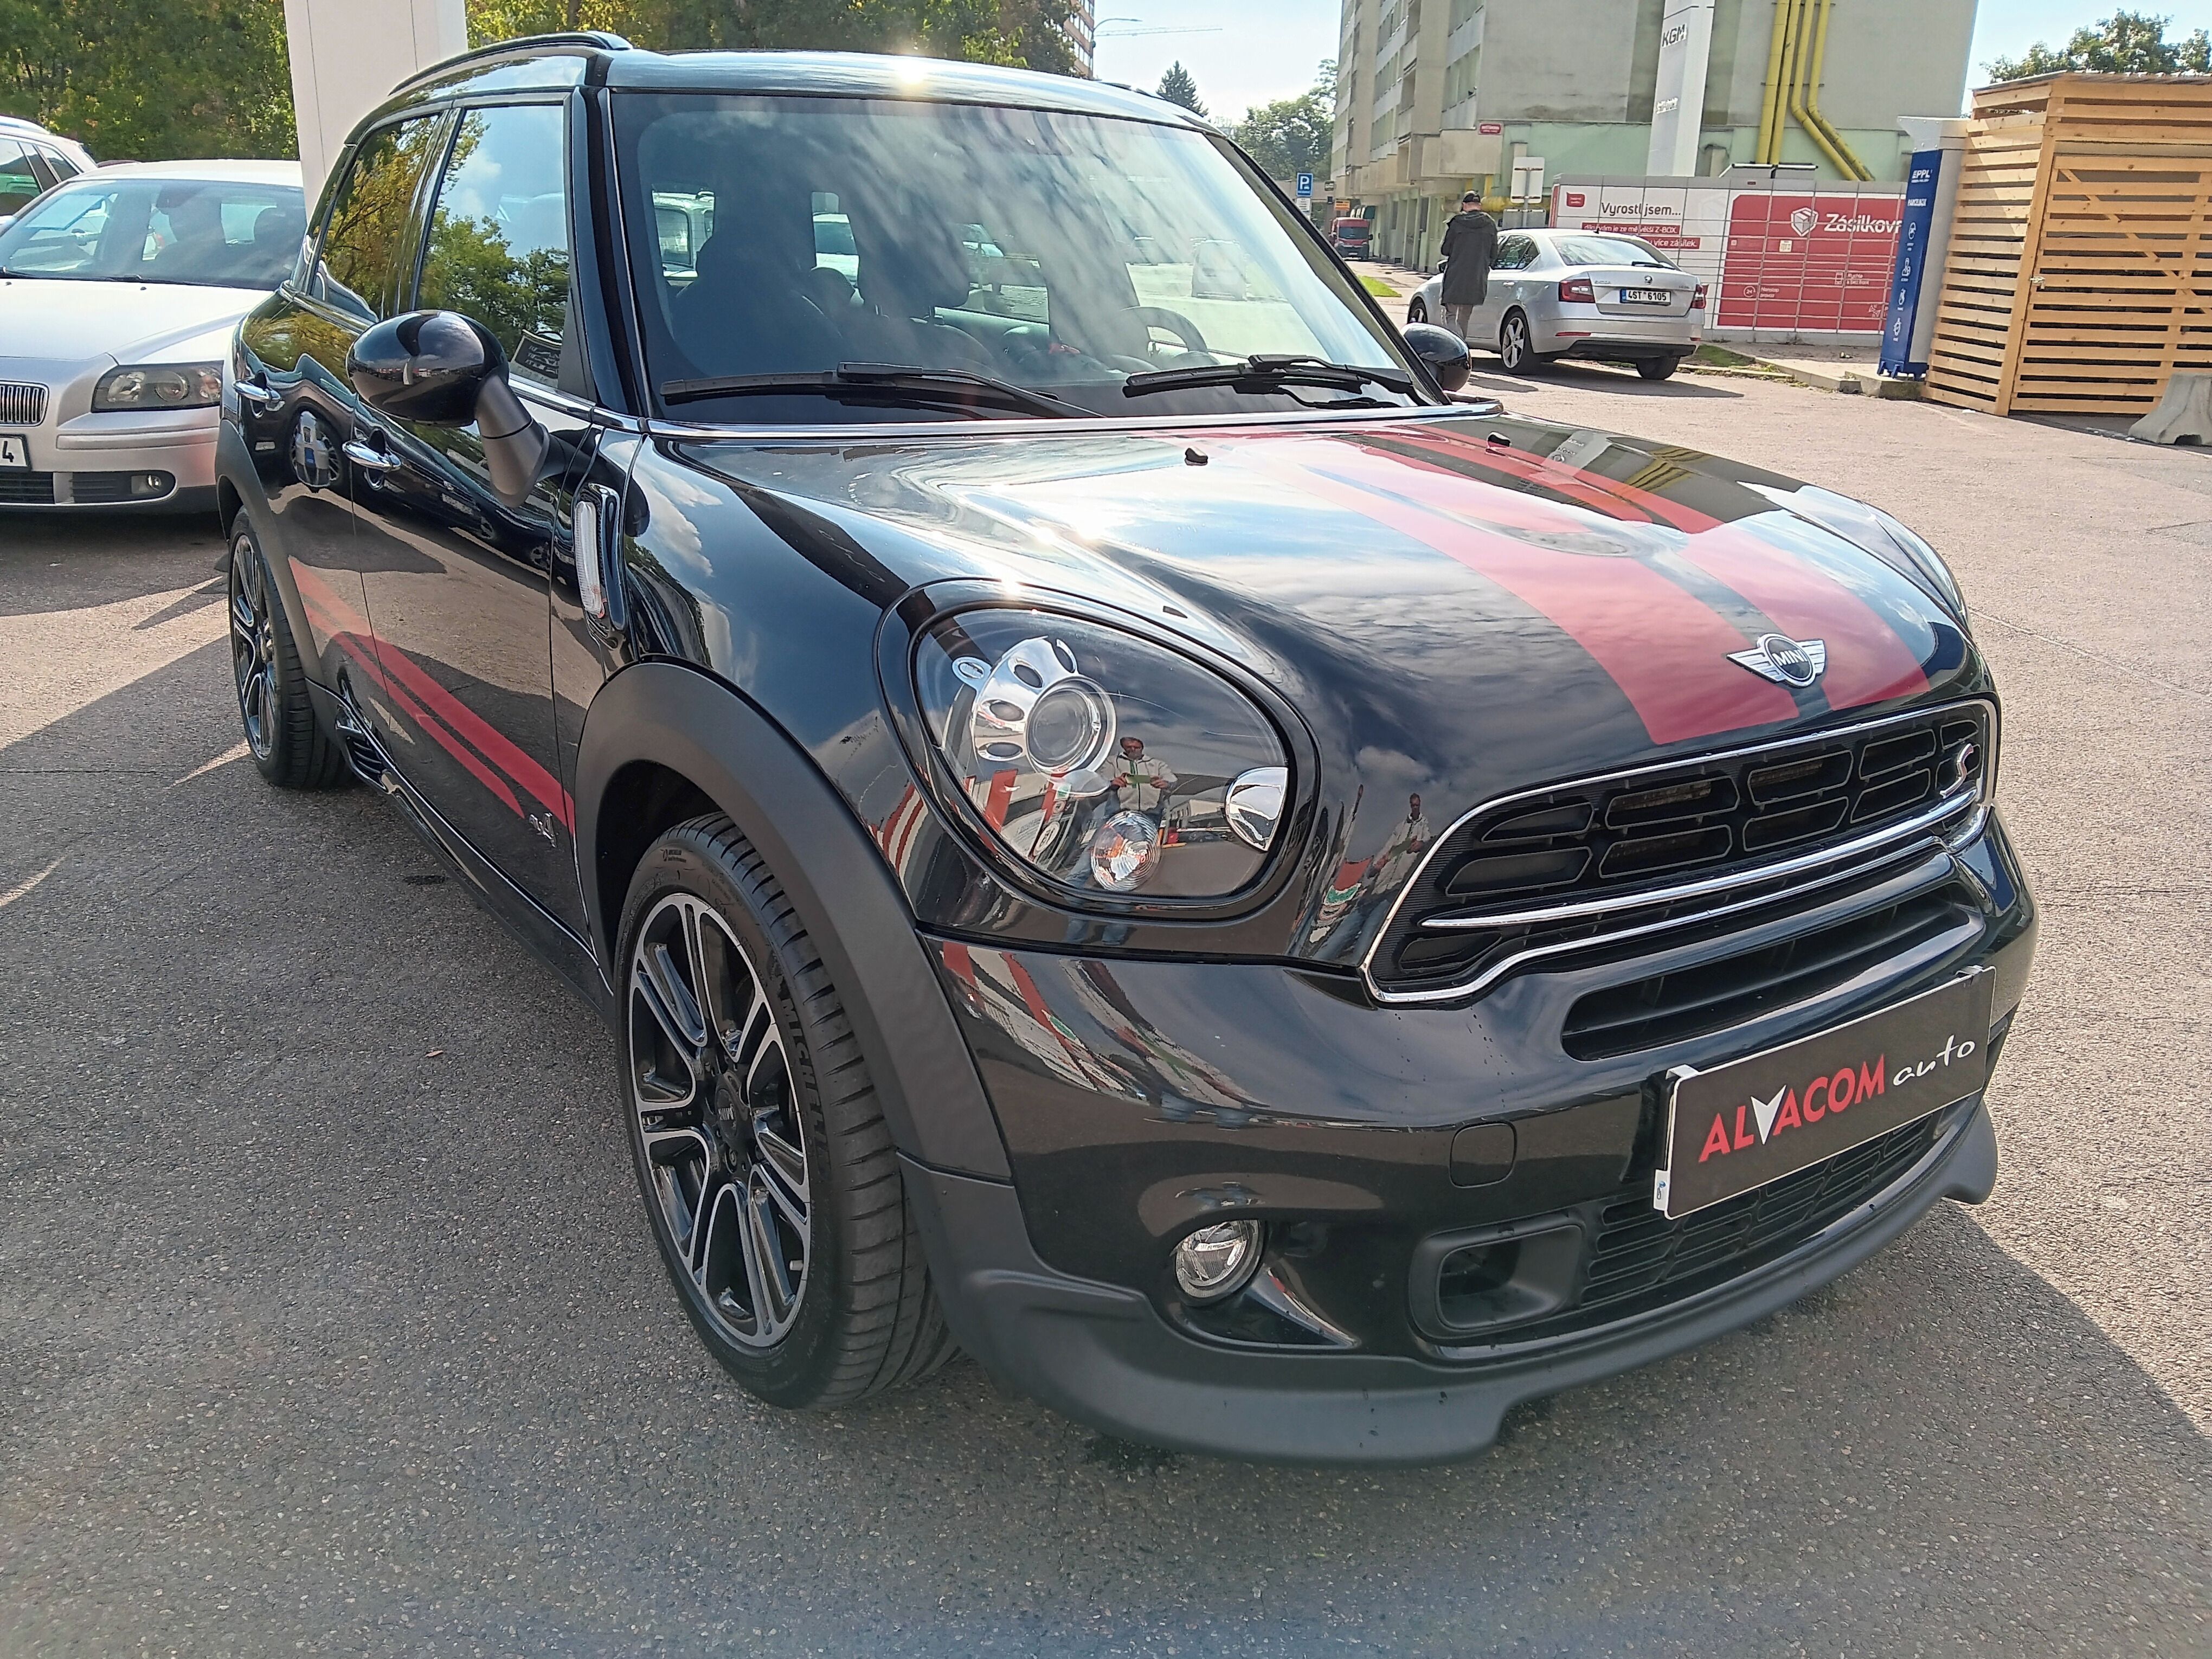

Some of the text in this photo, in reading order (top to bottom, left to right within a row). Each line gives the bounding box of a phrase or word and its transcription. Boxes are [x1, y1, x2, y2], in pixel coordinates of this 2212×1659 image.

[1662, 23, 1686, 47] KGM
[1300, 176, 1310, 190] P
[1601, 202, 1681, 216] Vyrostl jsem...
[1628, 290, 1667, 301] 4ST 6105
[1771, 649, 1808, 666] MINI
[1699, 1034, 1975, 1162] ALVACOM auto
